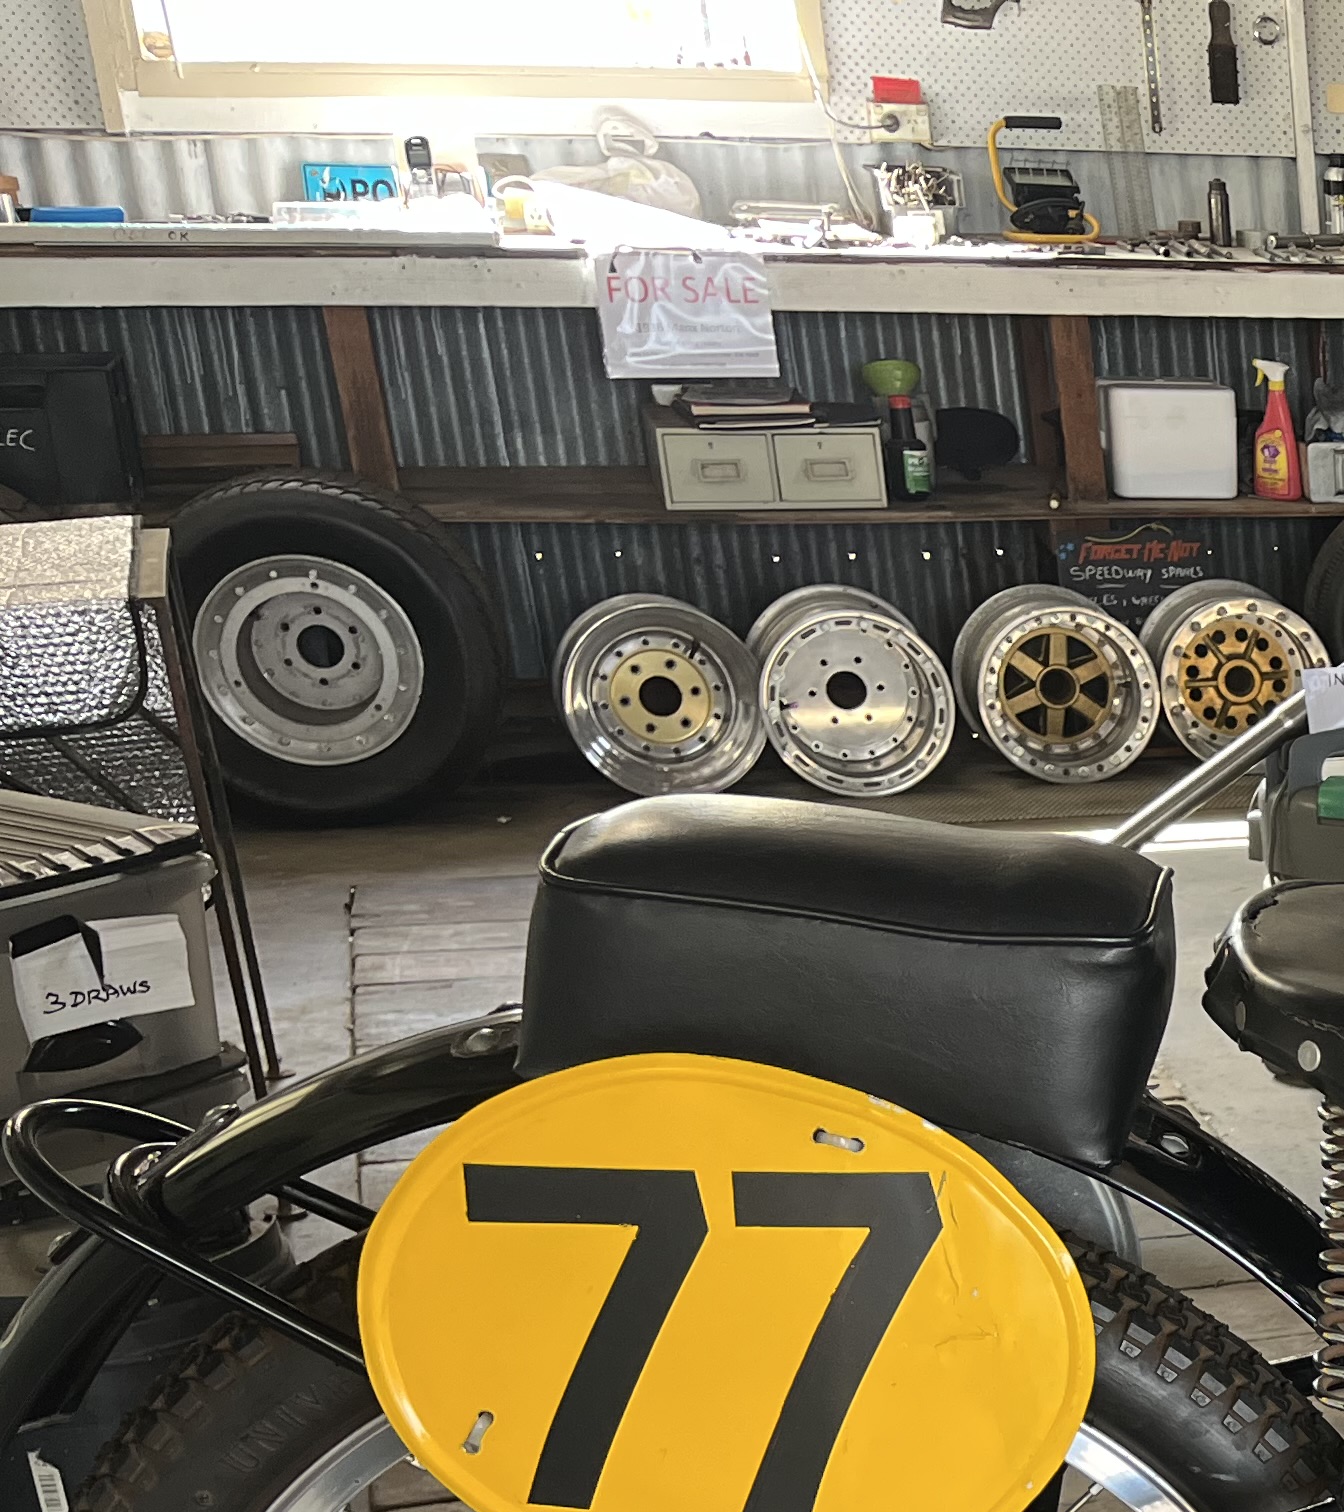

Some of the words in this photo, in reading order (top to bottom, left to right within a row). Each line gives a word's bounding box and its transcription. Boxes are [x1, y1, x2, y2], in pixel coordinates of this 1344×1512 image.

[606, 276, 671, 304] FOR
[682, 276, 760, 304] SALE
[1070, 565, 1153, 584] SPEEDWAY
[69, 980, 151, 1008] DRAWS
